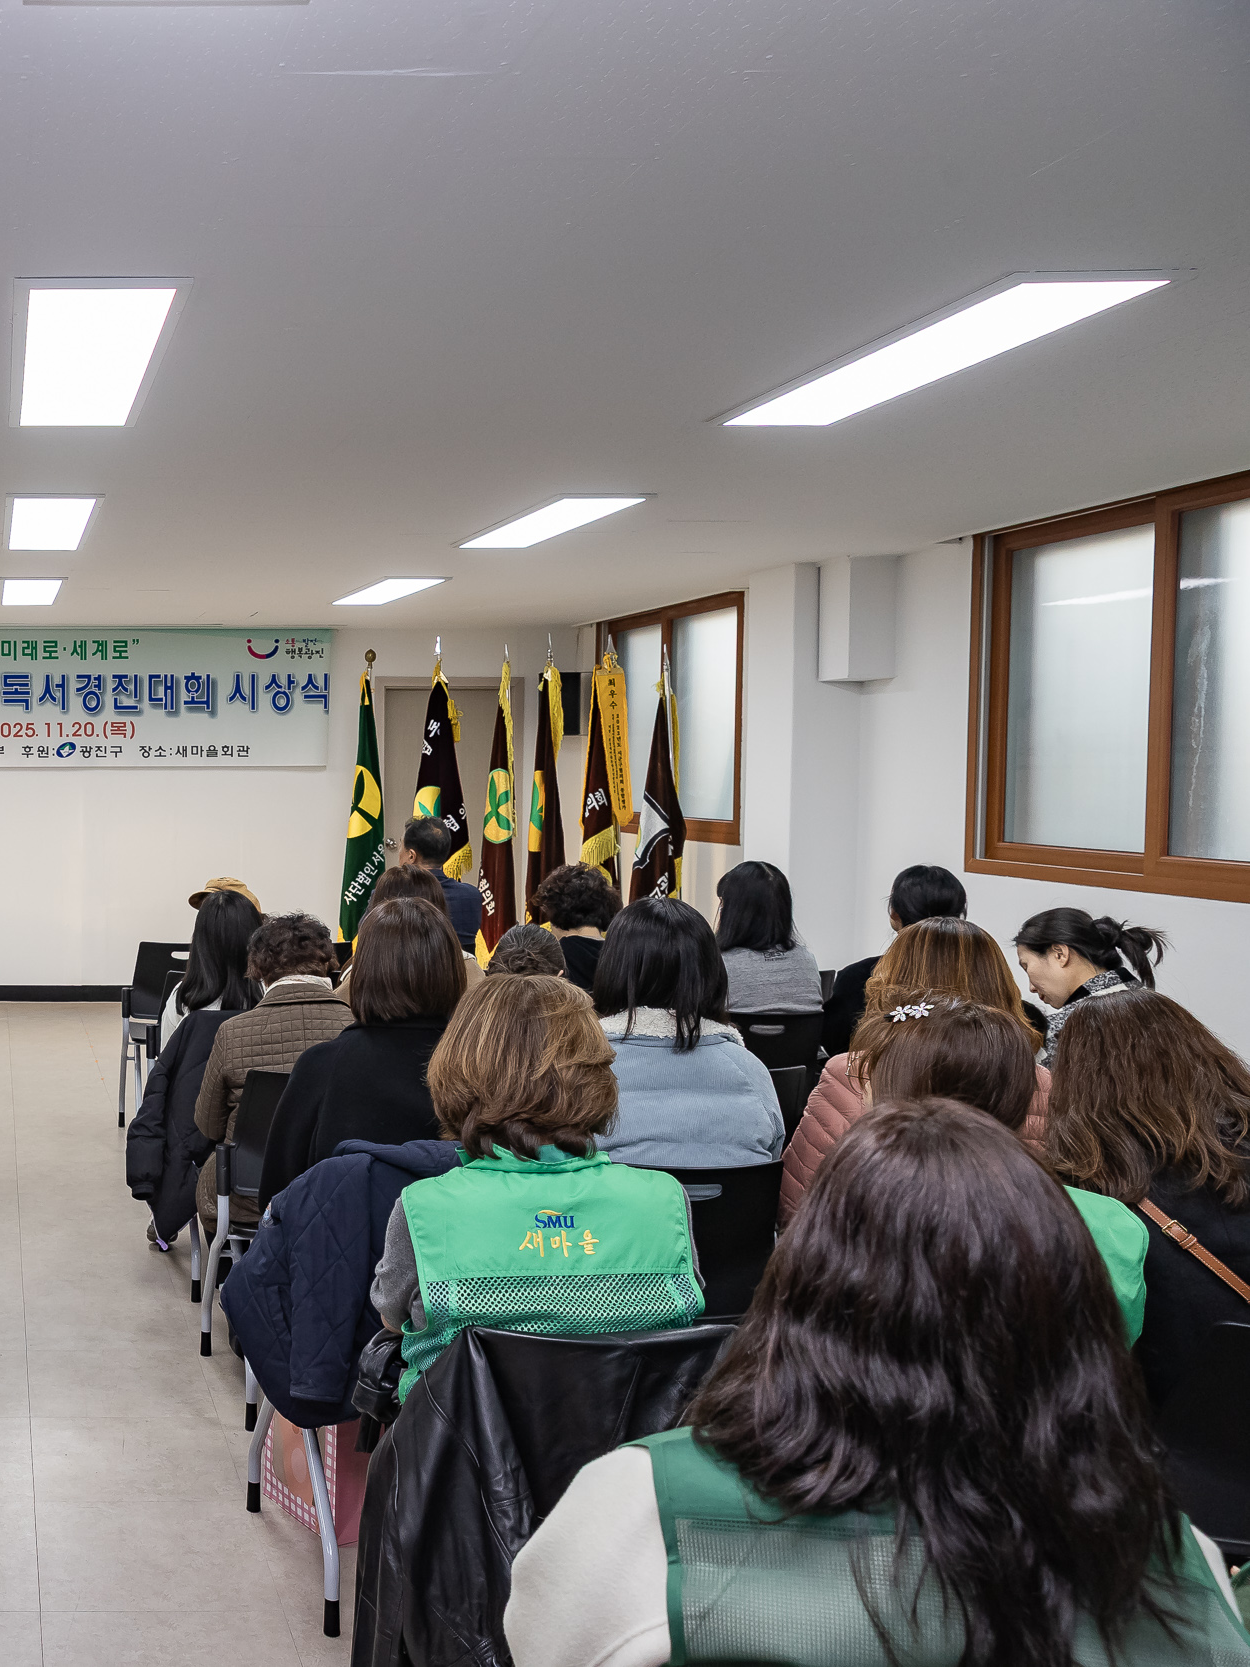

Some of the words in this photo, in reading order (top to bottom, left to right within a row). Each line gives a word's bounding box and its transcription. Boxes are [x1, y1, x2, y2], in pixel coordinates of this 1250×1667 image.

[285, 646, 324, 660] 행복광진
[1, 671, 212, 714] 독서경진대회
[227, 672, 329, 713] 시상식
[608, 677, 618, 710] 최우수
[21, 745, 55, 759] 후원:
[79, 745, 123, 759] 광진구
[343, 862, 378, 905] 사단법인
[479, 868, 495, 917] 협의회
[534, 1214, 576, 1229] SMU
[518, 1229, 600, 1258] 새마을
